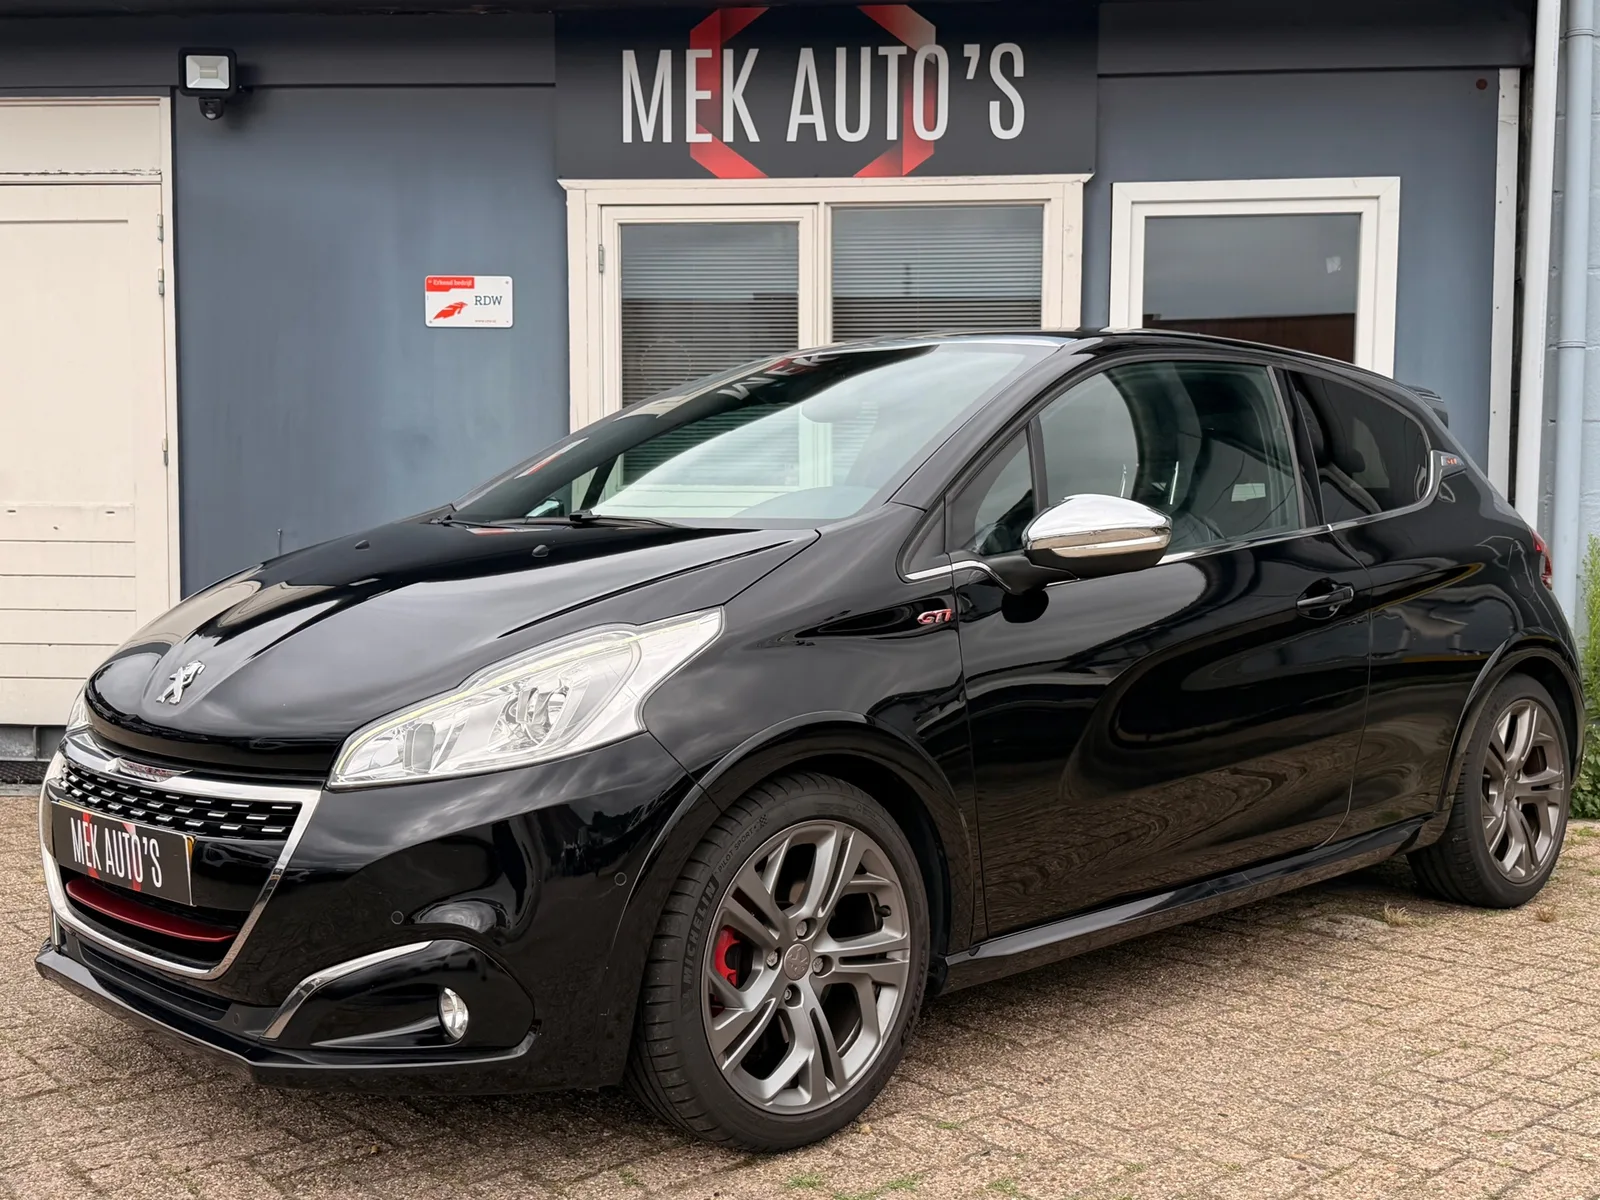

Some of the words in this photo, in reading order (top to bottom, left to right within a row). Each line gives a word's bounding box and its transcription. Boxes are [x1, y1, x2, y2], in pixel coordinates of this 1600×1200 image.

[621, 48, 761, 144] MEK
[785, 42, 1026, 143] AUTO'S
[474, 295, 503, 306] RDW
[70, 817, 102, 871] MEK
[104, 827, 163, 889] AUTO'S
[717, 850, 734, 873] PILOT
[734, 827, 754, 851] SPORT
[682, 882, 717, 986] MICHELIN
